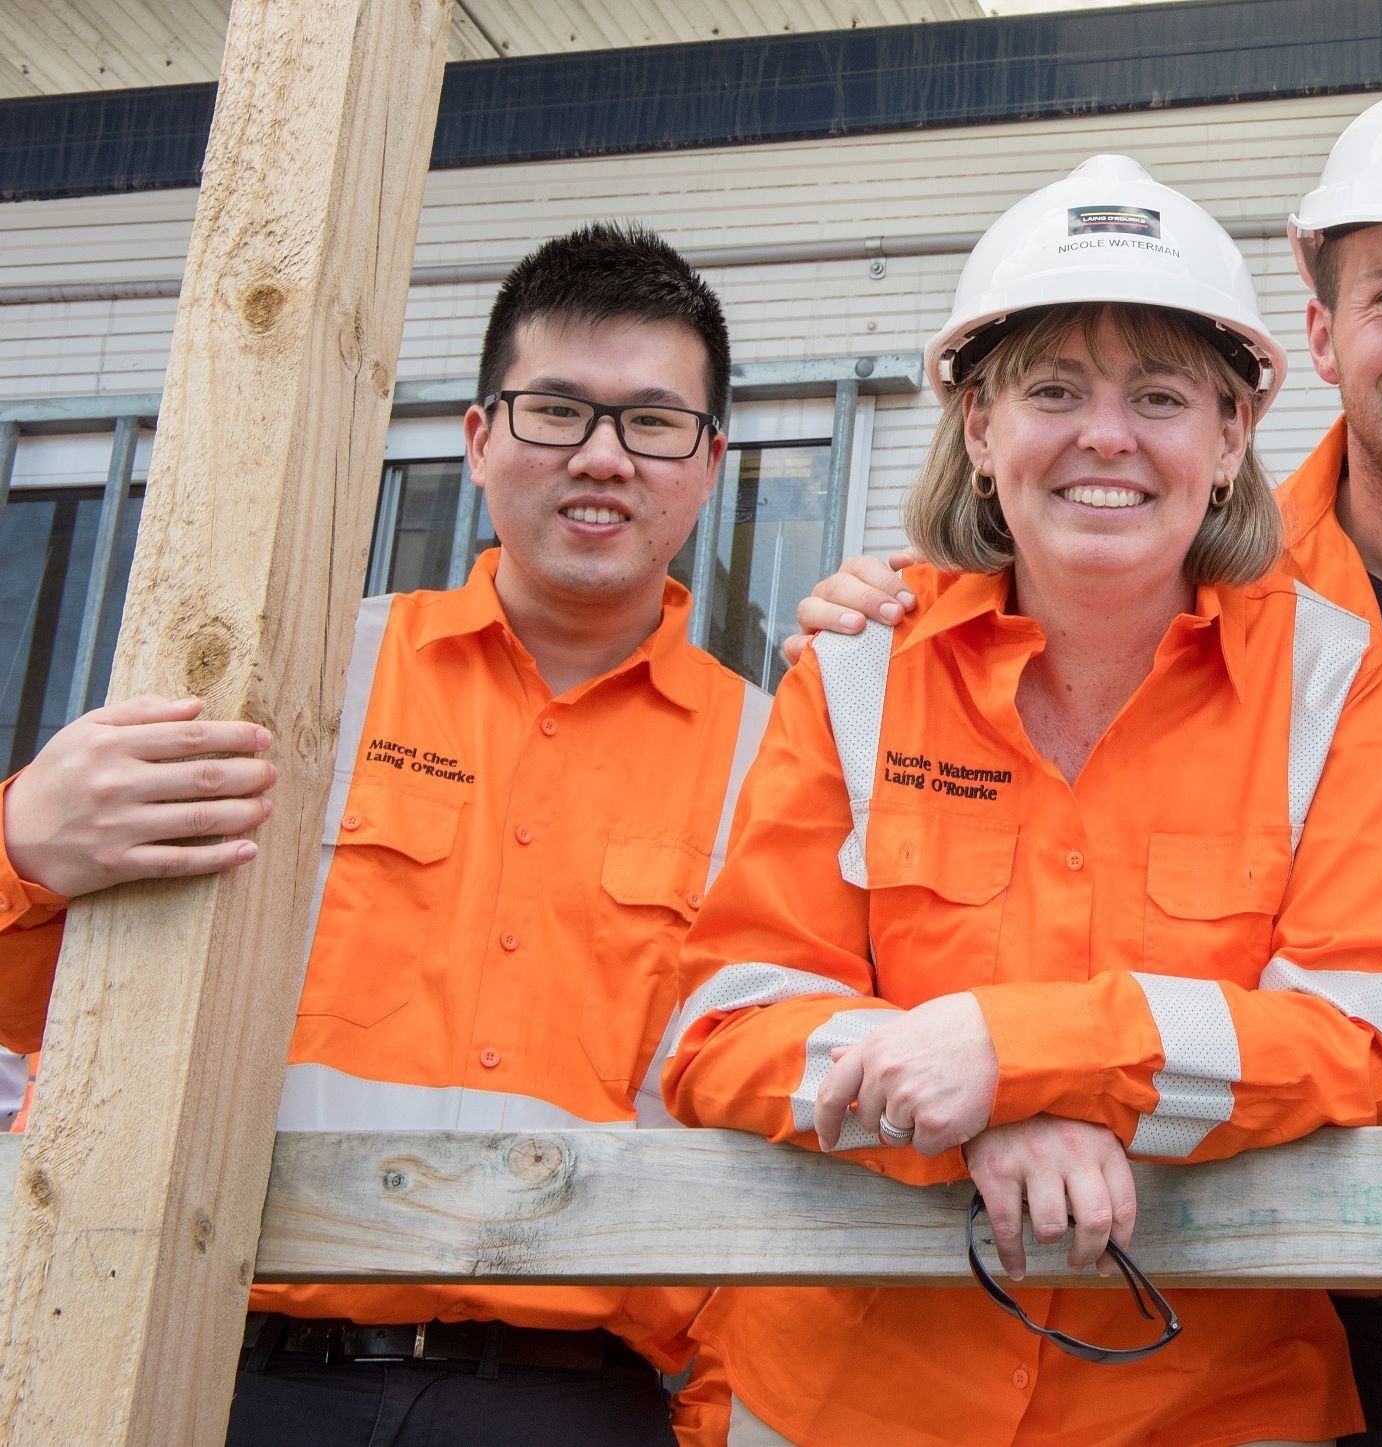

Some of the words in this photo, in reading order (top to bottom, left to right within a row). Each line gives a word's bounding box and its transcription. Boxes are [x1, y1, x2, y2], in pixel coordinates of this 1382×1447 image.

[1107, 215, 1146, 223] O'ROURKE
[1058, 239, 1105, 254] NICOLE
[1108, 239, 1180, 258] WATERMAN
[366, 752, 405, 769] Laing
[411, 761, 475, 784] O'Rourke
[369, 739, 418, 758] Marcel
[422, 752, 458, 767] Chee
[886, 750, 932, 771] Nicole
[938, 761, 1012, 783] Waterman
[884, 768, 925, 790] Laing
[931, 778, 998, 801] O'Rourke
